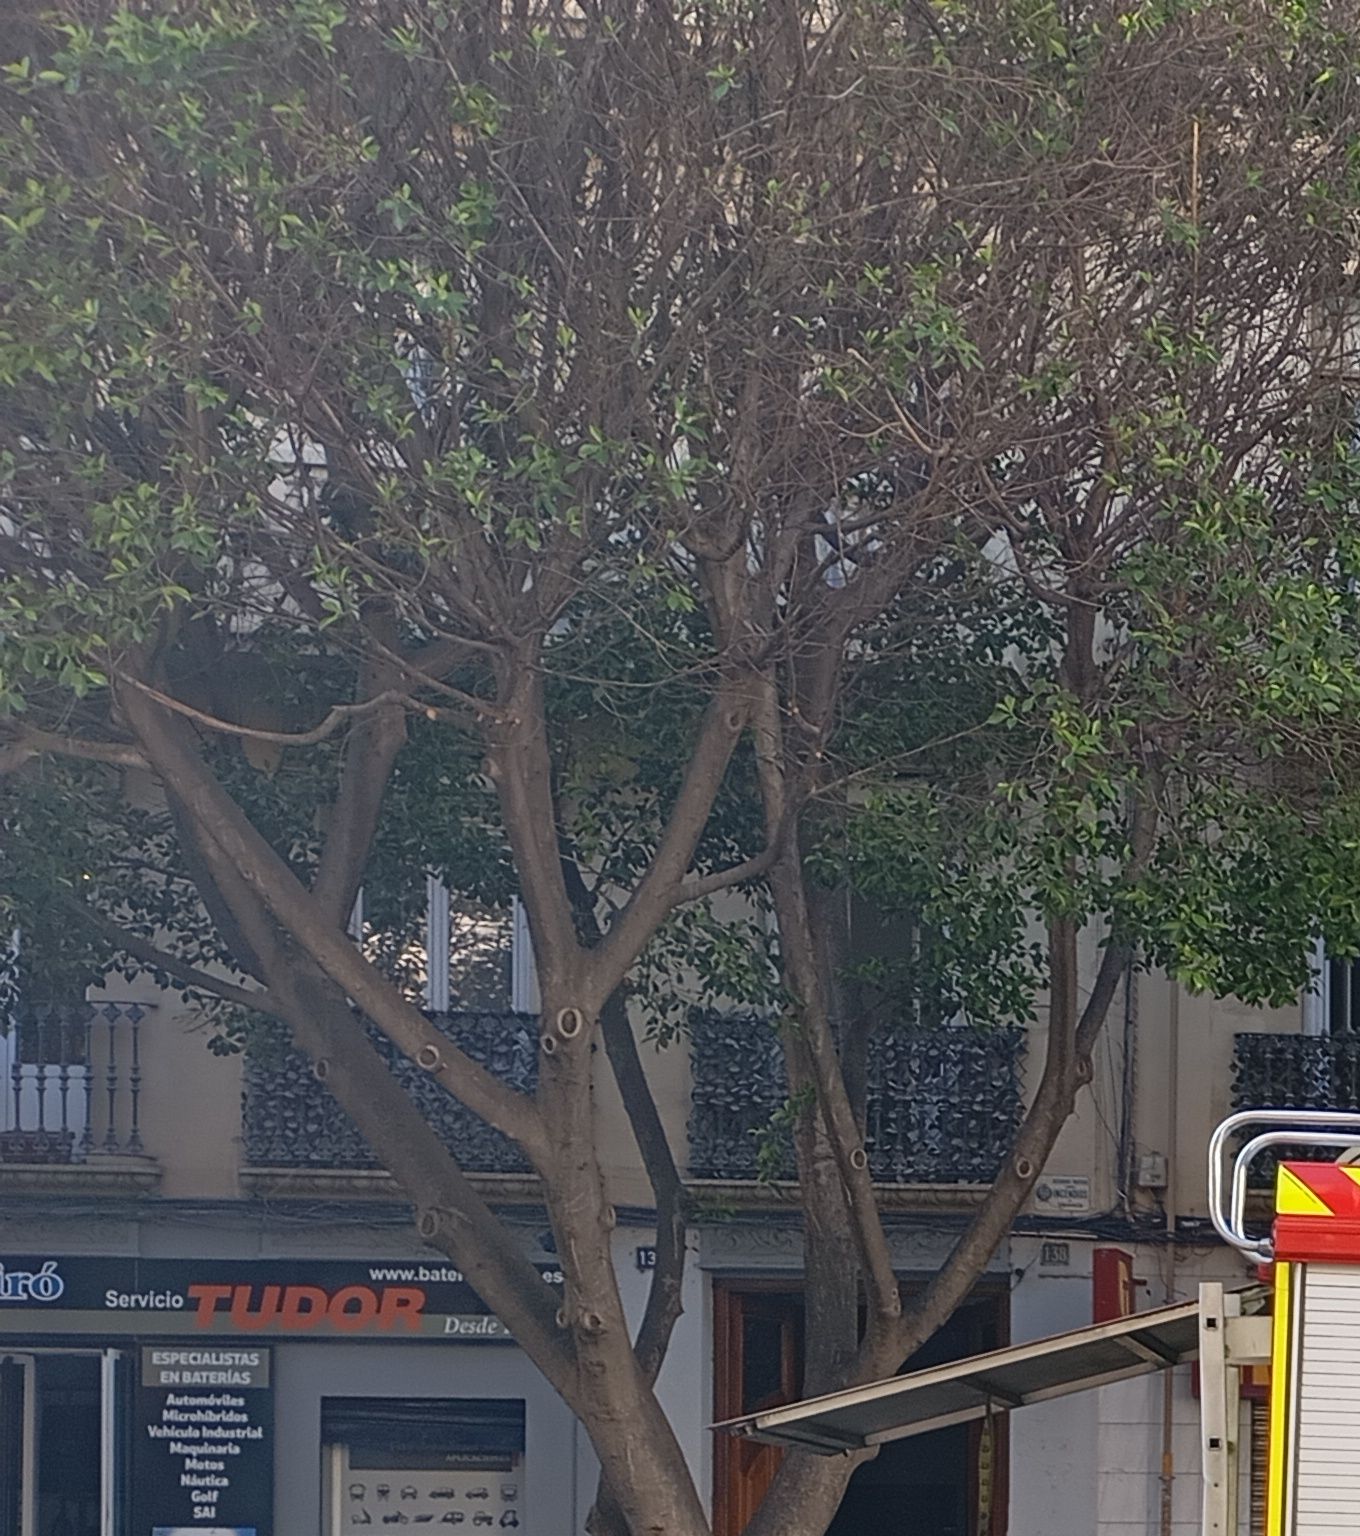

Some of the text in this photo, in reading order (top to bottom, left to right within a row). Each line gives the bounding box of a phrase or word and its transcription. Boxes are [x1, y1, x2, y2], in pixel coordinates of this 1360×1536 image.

[105, 1284, 426, 1332] Servicio TUDOR
[444, 1316, 498, 1334] Desde
[152, 1352, 260, 1366] ESPECIALISTAS
[160, 1369, 251, 1385] EN BATERÍAS
[166, 1393, 246, 1407] Automóviles
[162, 1409, 249, 1423] Microhíbridos
[202, 1426, 263, 1439] Industrial
[169, 1441, 241, 1457] Maquinaria
[185, 1458, 225, 1471] Motos
[180, 1474, 229, 1487] Náutica
[191, 1490, 220, 1503] Golf
[193, 1507, 216, 1518] SAI
